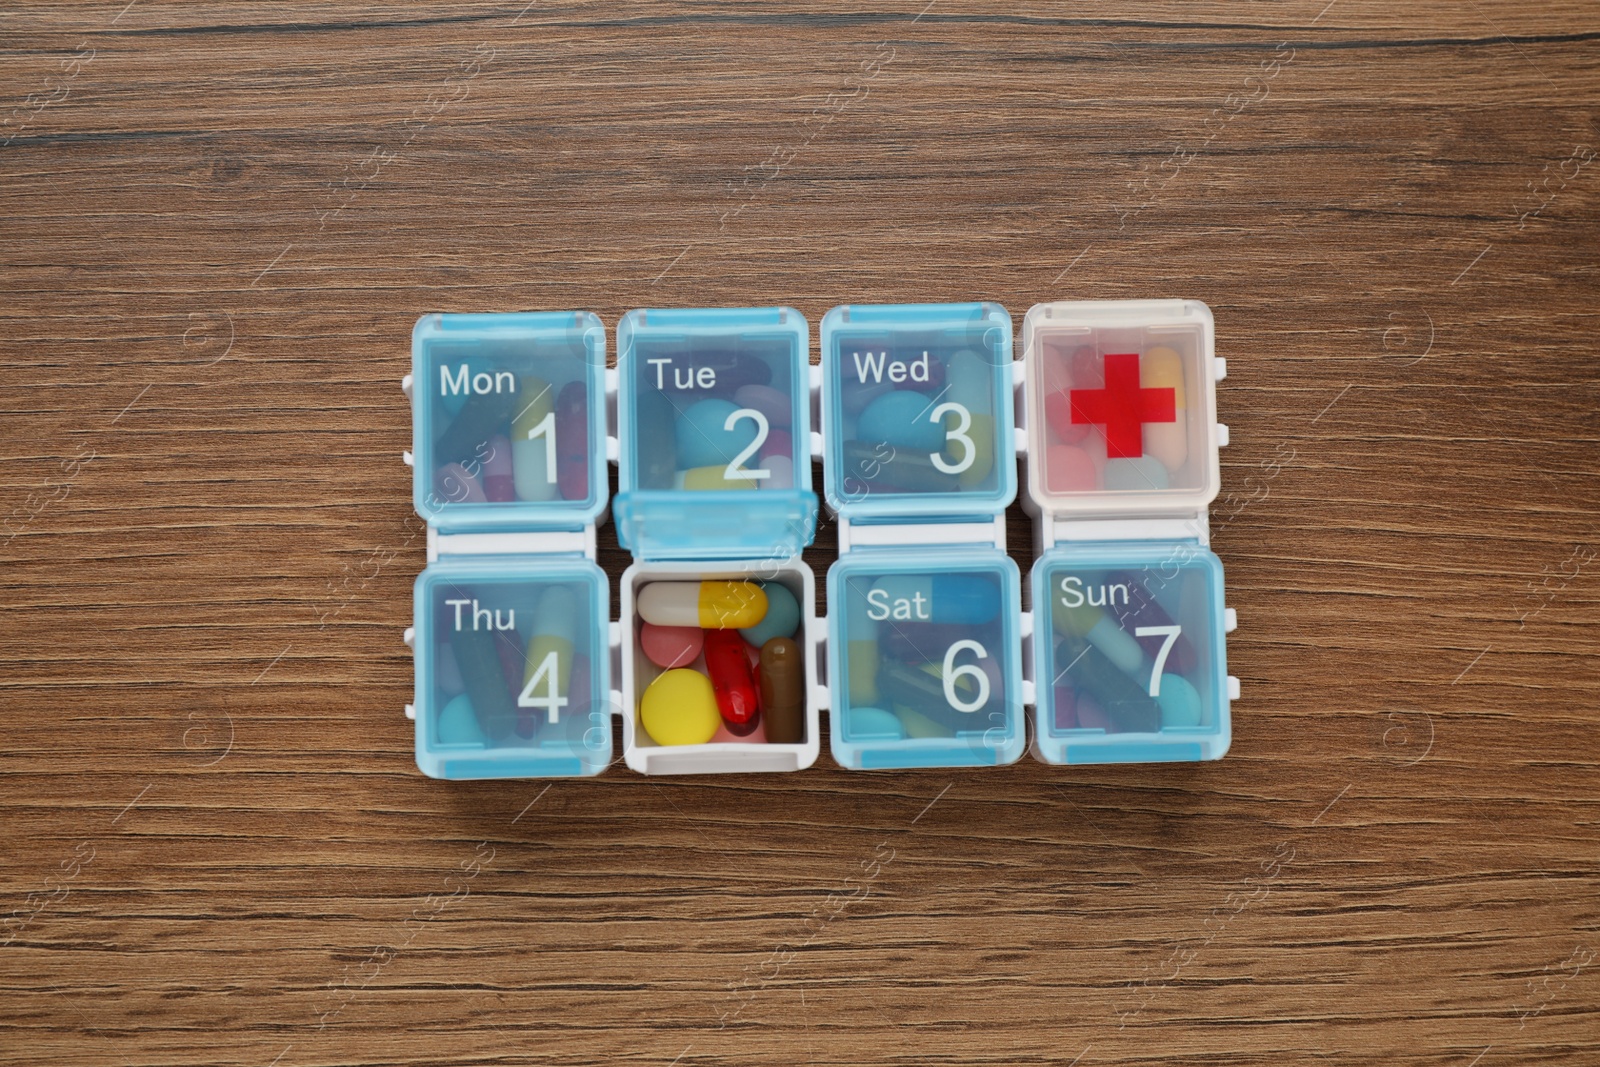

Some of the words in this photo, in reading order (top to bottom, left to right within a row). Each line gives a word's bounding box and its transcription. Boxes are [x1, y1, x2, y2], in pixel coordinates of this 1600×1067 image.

[439, 364, 516, 396] Mon
[647, 358, 716, 390] Tue
[853, 351, 929, 384] Wed
[528, 412, 557, 484] 1
[723, 408, 771, 481] 2
[929, 402, 976, 475] 3
[445, 599, 515, 631] Thu
[867, 588, 929, 620] Sat
[1060, 576, 1129, 608] Sun
[942, 639, 990, 713] 6
[1135, 625, 1182, 697] 7
[517, 651, 568, 724] 4
